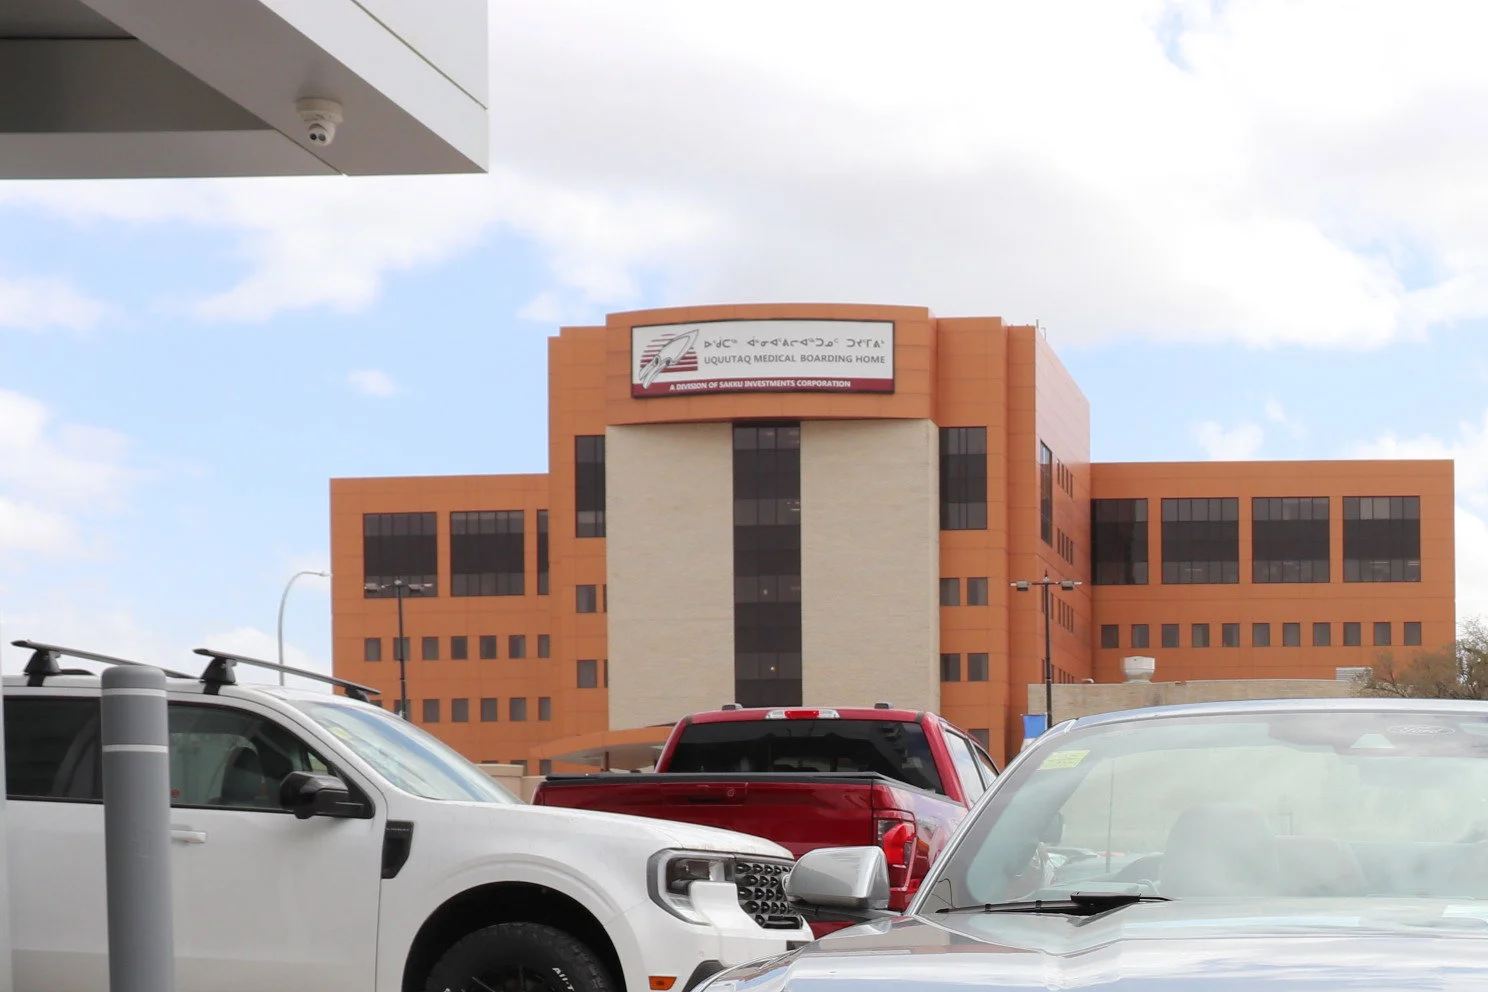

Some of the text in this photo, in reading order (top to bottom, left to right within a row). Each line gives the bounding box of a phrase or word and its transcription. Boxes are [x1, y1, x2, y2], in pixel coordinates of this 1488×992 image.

[704, 353, 886, 366] UQUUTAQ MEDICAL BOARDING HOME
[669, 383, 676, 391] A
[676, 382, 708, 391] DIVISION
[708, 381, 718, 389] OF
[743, 379, 796, 388] INVESTMENTS
[796, 379, 851, 388] CORPORATION
